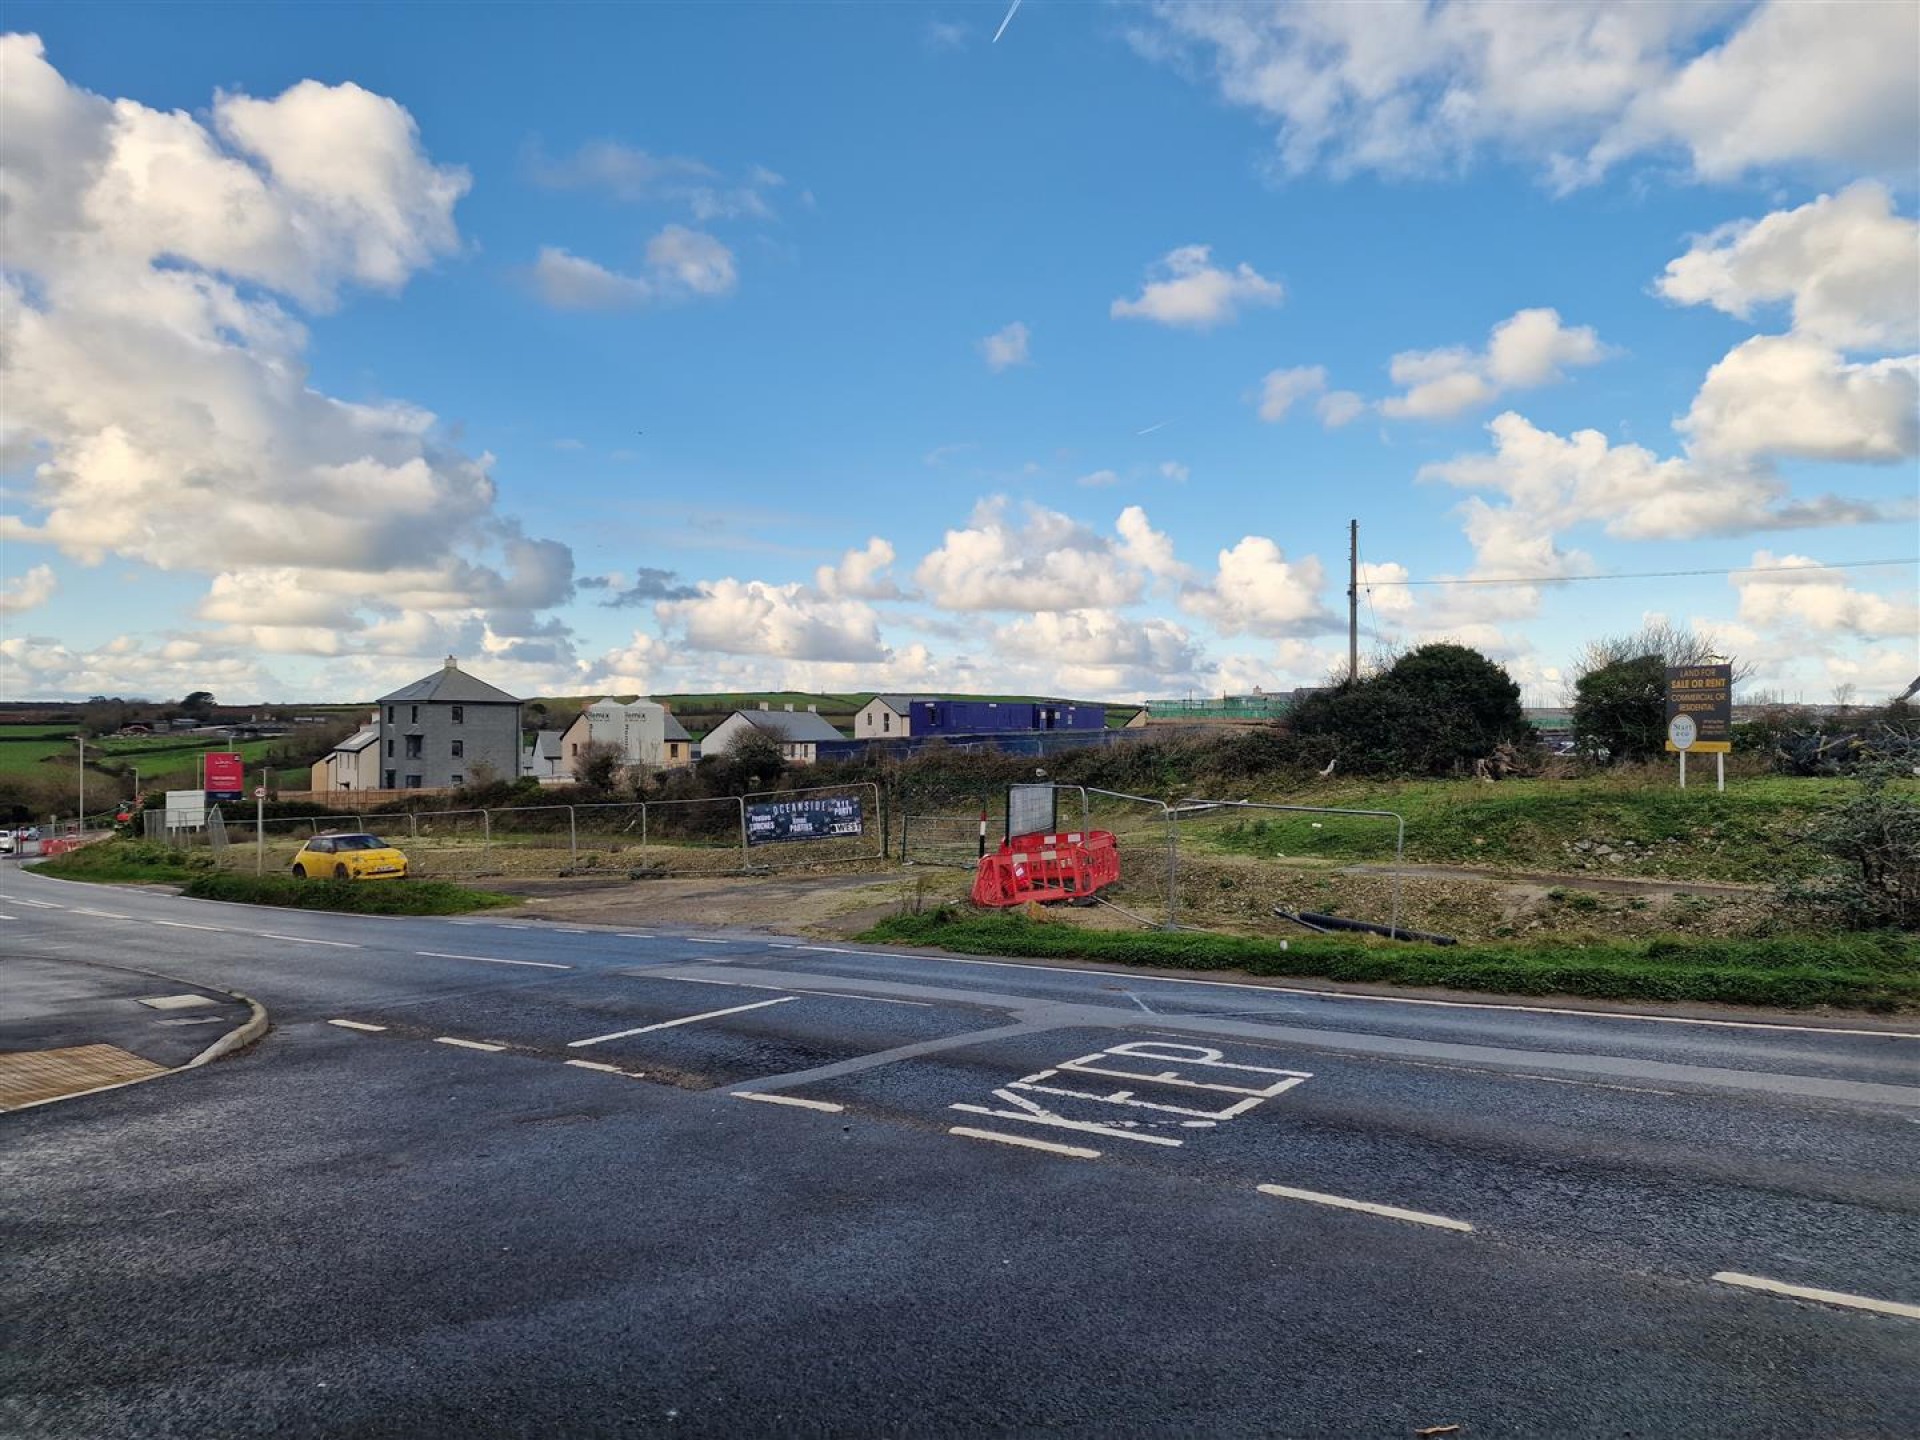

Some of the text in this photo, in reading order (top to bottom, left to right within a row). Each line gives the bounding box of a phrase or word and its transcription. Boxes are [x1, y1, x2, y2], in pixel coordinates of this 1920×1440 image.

[1680, 668, 1717, 677] LAND FOR
[1671, 678, 1726, 689] SALE OR RENT
[1671, 692, 1727, 702] COMMERCIAL OR
[1679, 703, 1715, 712] RESIDENTIAL
[772, 800, 826, 816] OCEANSIDE
[949, 1042, 1313, 1147] KEEP
